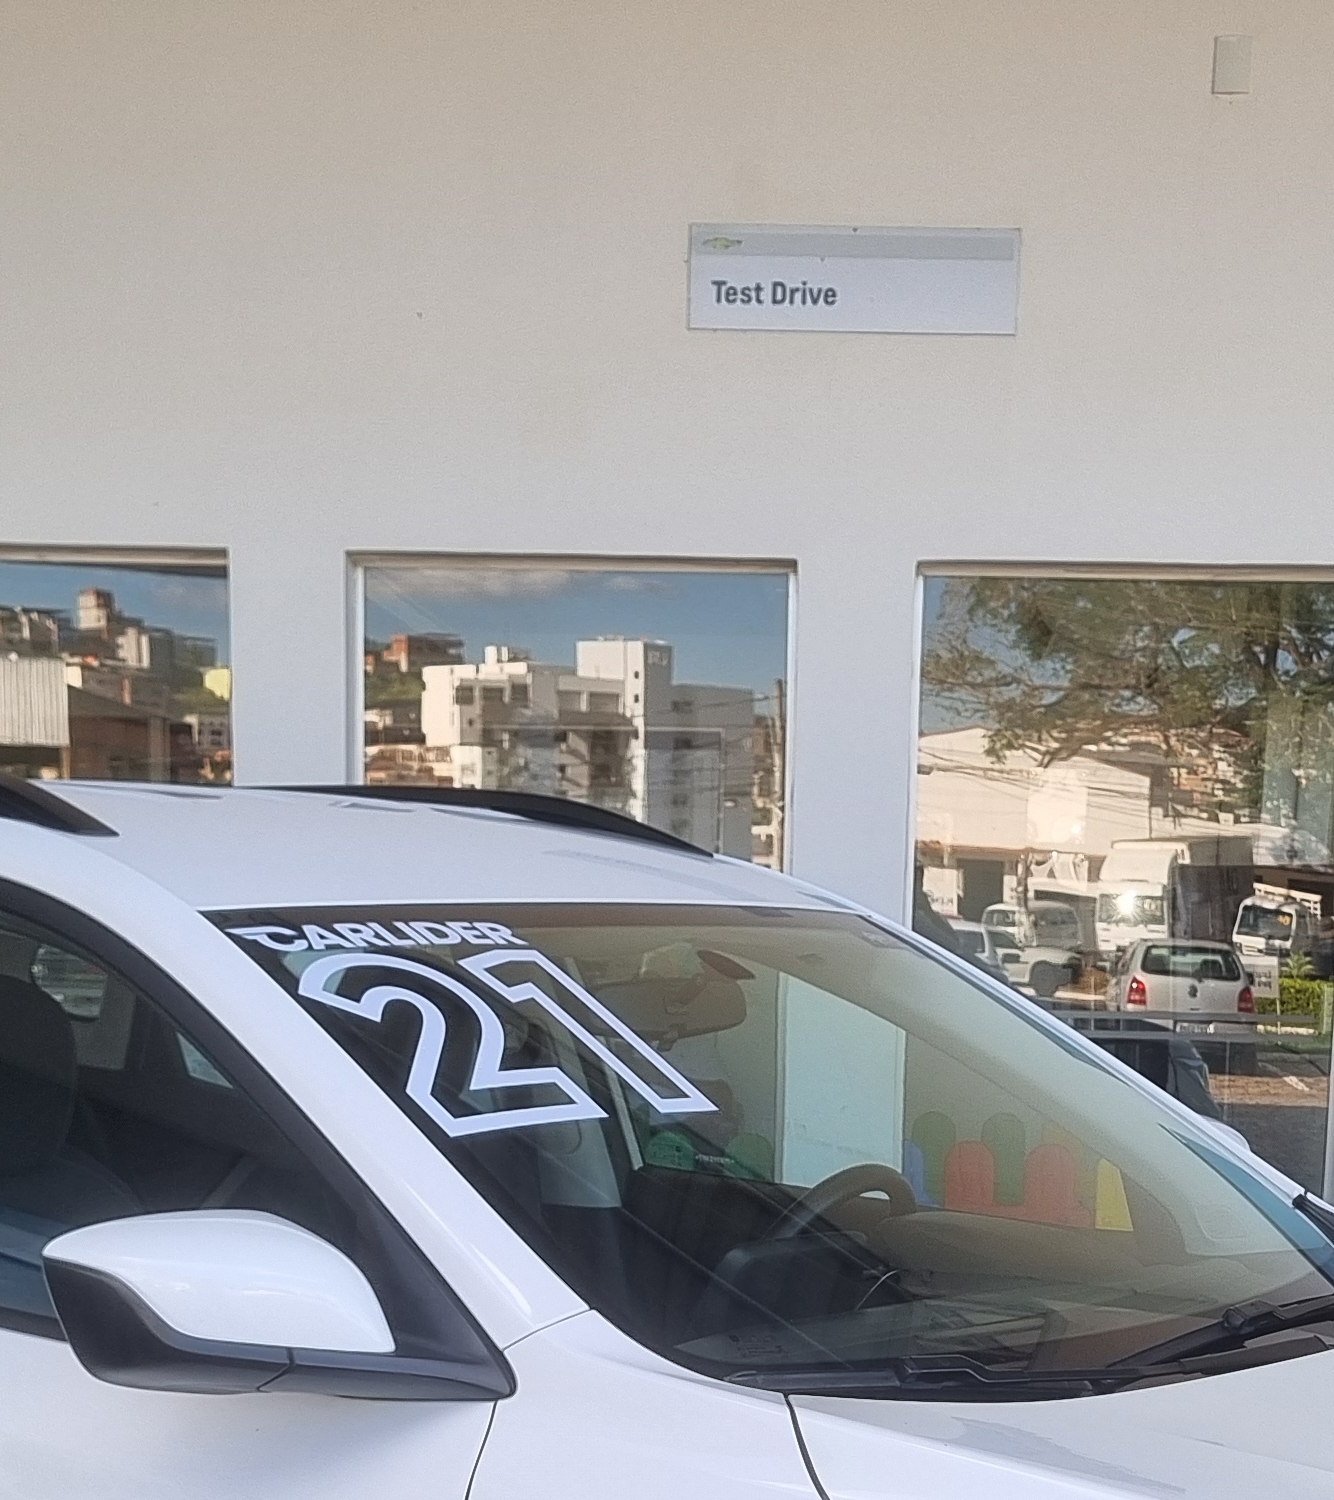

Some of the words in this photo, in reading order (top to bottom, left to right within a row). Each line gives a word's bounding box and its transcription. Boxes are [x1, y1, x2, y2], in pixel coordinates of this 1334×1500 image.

[711, 279, 764, 306] Test
[771, 280, 837, 306] Drive
[224, 921, 529, 952] CARLIDER
[297, 948, 719, 1137] 21
